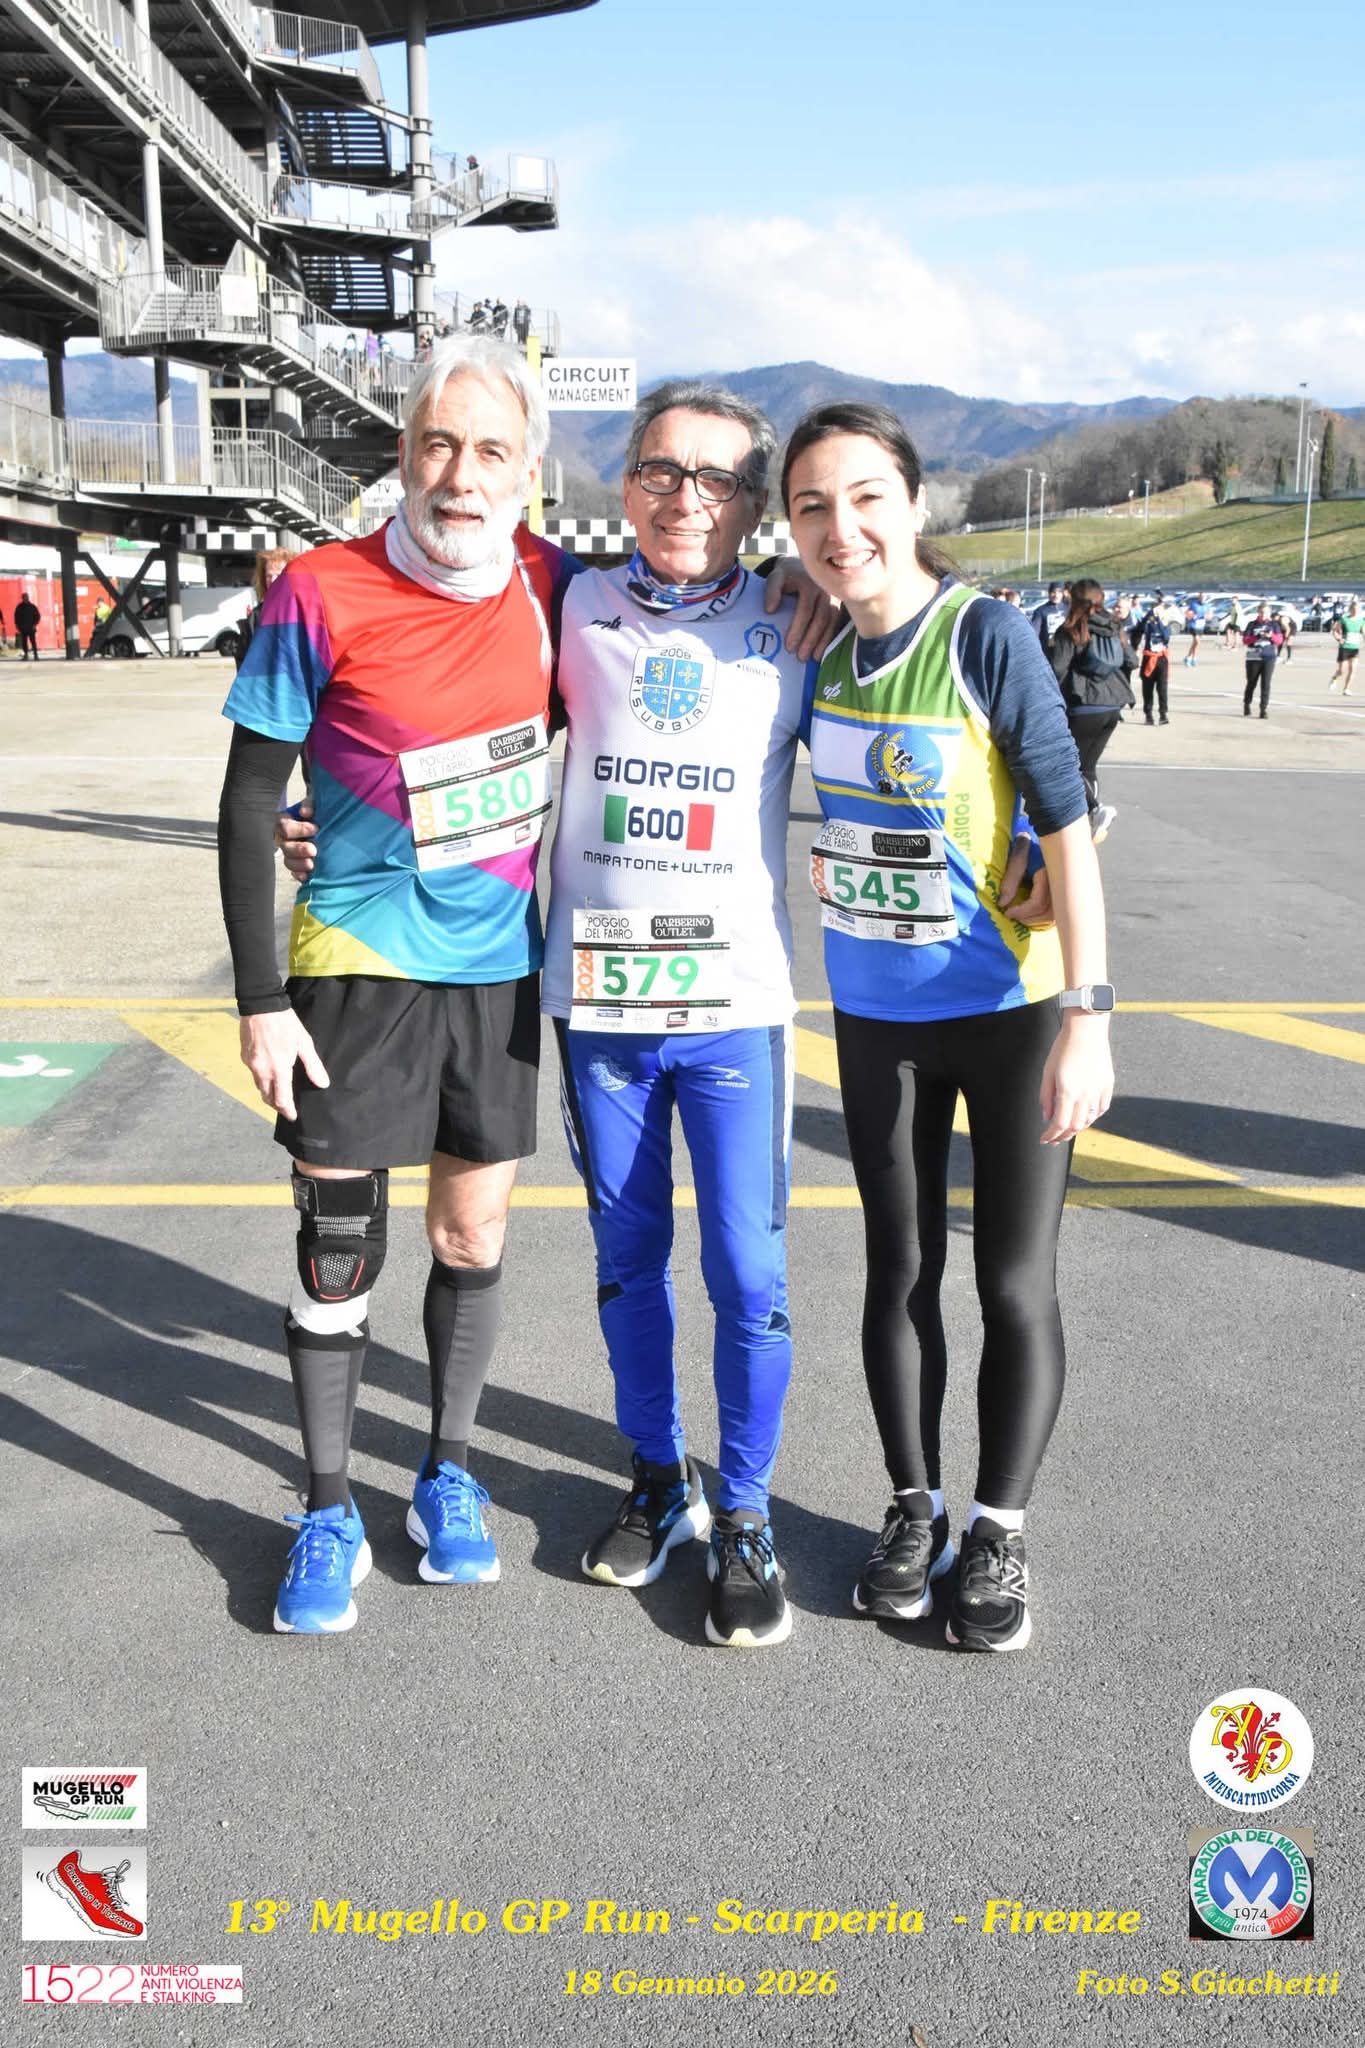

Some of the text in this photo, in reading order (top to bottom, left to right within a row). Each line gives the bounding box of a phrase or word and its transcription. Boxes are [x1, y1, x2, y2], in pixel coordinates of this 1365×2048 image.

[549, 367, 631, 383] CIRCUIT
[549, 388, 631, 401] MANAGEMENT
[375, 483, 391, 494] TV
[754, 629, 774, 654] T
[632, 675, 711, 731] RISUBBIANI
[490, 727, 534, 748] BARBERINO
[594, 755, 736, 793] GIORGIO
[445, 769, 534, 829] 580
[627, 805, 685, 841] 600
[834, 838, 859, 852] FARRO
[874, 836, 926, 848] BARBERINO
[583, 850, 734, 875] MARATONE+ULTRA
[832, 864, 922, 912] 545
[587, 916, 630, 928] POGGIO
[654, 917, 711, 928] BARBERINO
[584, 928, 633, 940] DEL FARRO
[576, 948, 594, 1000] 2026
[602, 955, 700, 997] 579
